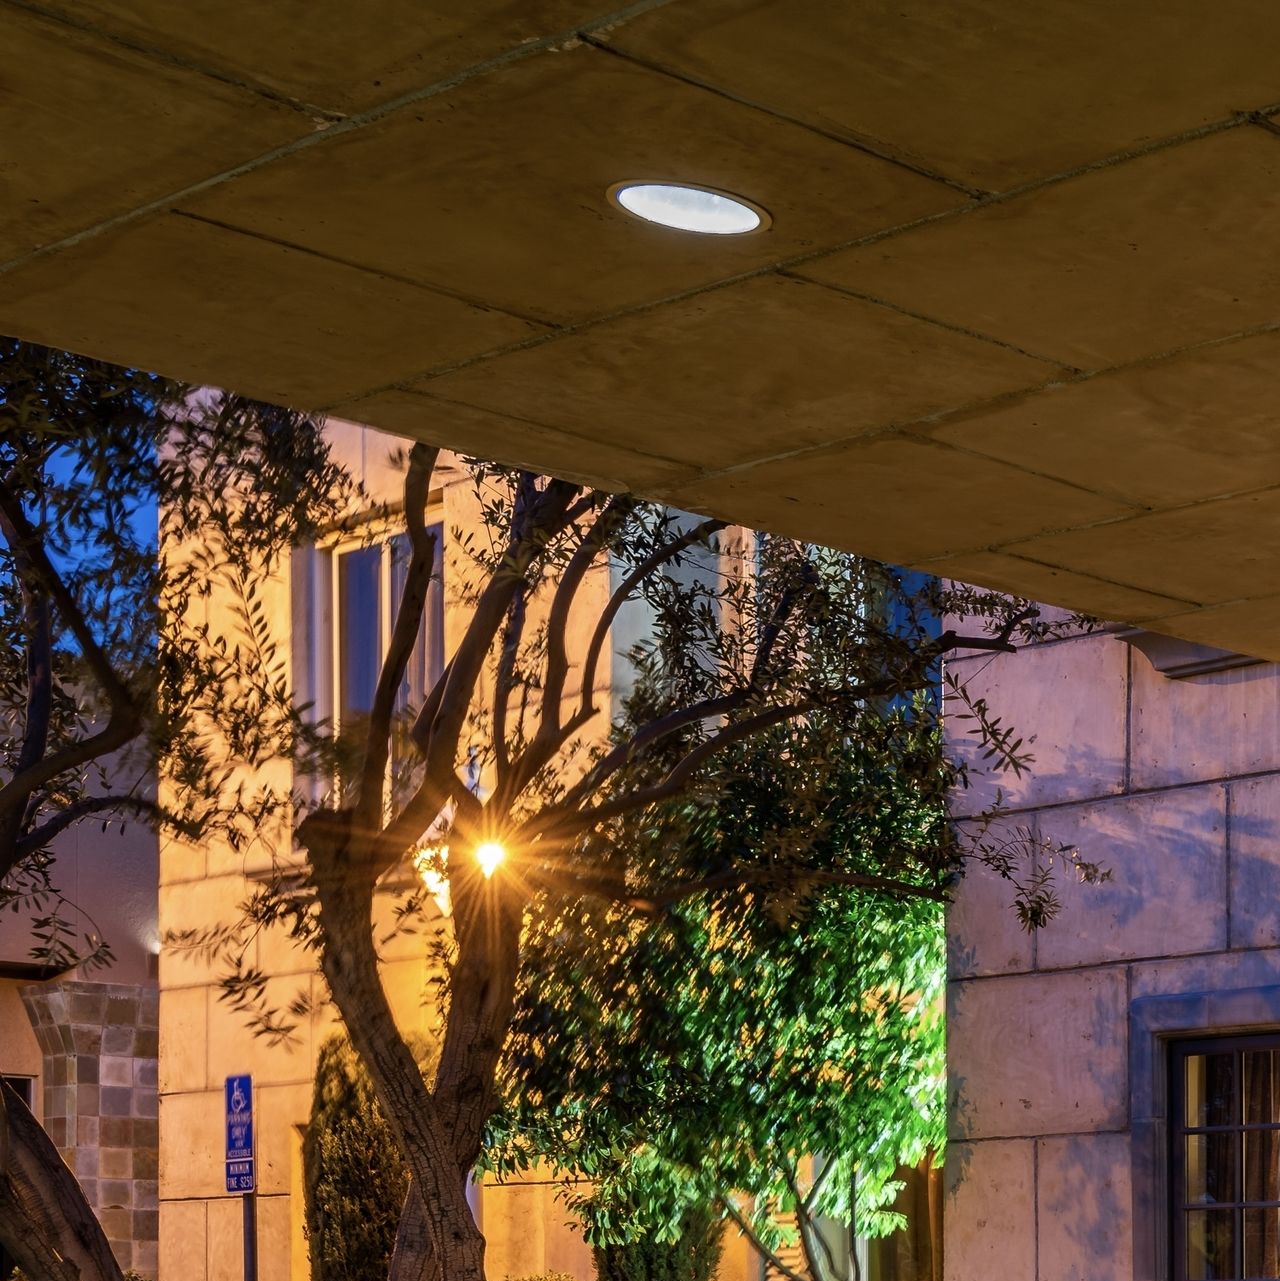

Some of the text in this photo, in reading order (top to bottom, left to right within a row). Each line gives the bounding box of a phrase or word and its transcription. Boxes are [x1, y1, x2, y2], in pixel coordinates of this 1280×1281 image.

[228, 1112, 251, 1125] PARKING
[231, 1126, 247, 1139] ONLY
[228, 1149, 251, 1158] ACCESSIBLE
[229, 1162, 250, 1175] MINIMUM
[227, 1175, 253, 1189] FINE $250
